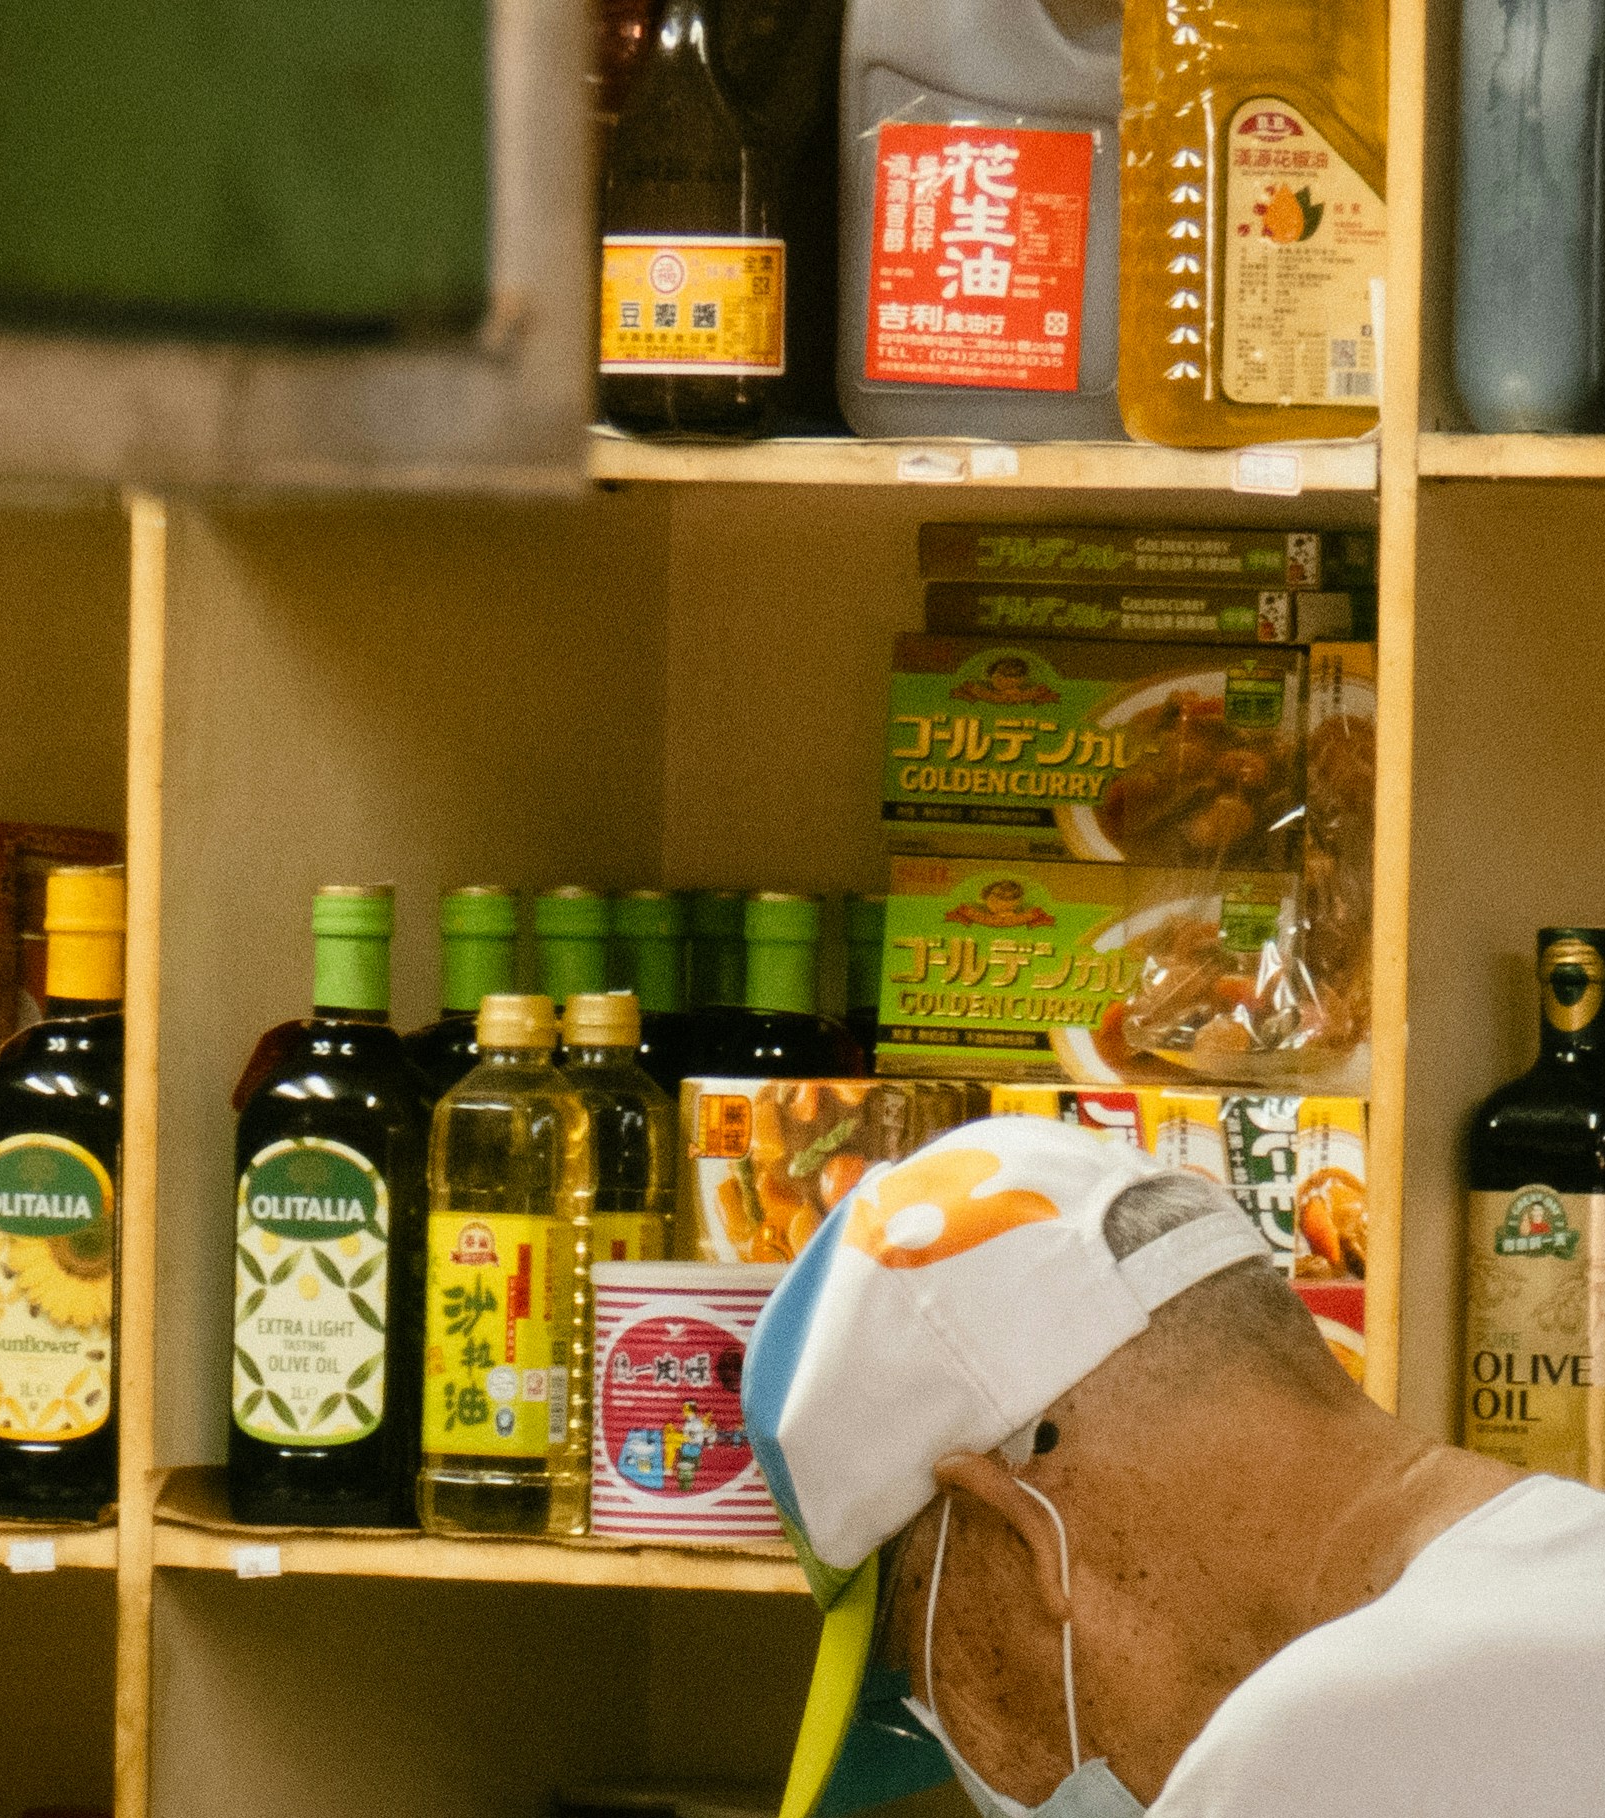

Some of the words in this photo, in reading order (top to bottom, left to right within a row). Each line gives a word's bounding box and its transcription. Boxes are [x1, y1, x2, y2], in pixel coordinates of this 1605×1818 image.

[936, 142, 1020, 299] 花生油
[892, 712, 1161, 769] ゴールデンカレー
[889, 936, 1143, 995] ゴールデンカレ
[250, 1193, 366, 1222] OLITALIA
[257, 1318, 304, 1337] EXTRA
[308, 1320, 356, 1338] LIGHT
[268, 1354, 309, 1373] OLIVE
[315, 1356, 342, 1375] OIL
[441, 1273, 498, 1433] 沙拉油
[1472, 1350, 1595, 1387] OLIVE
[1471, 1387, 1543, 1422] OIL
